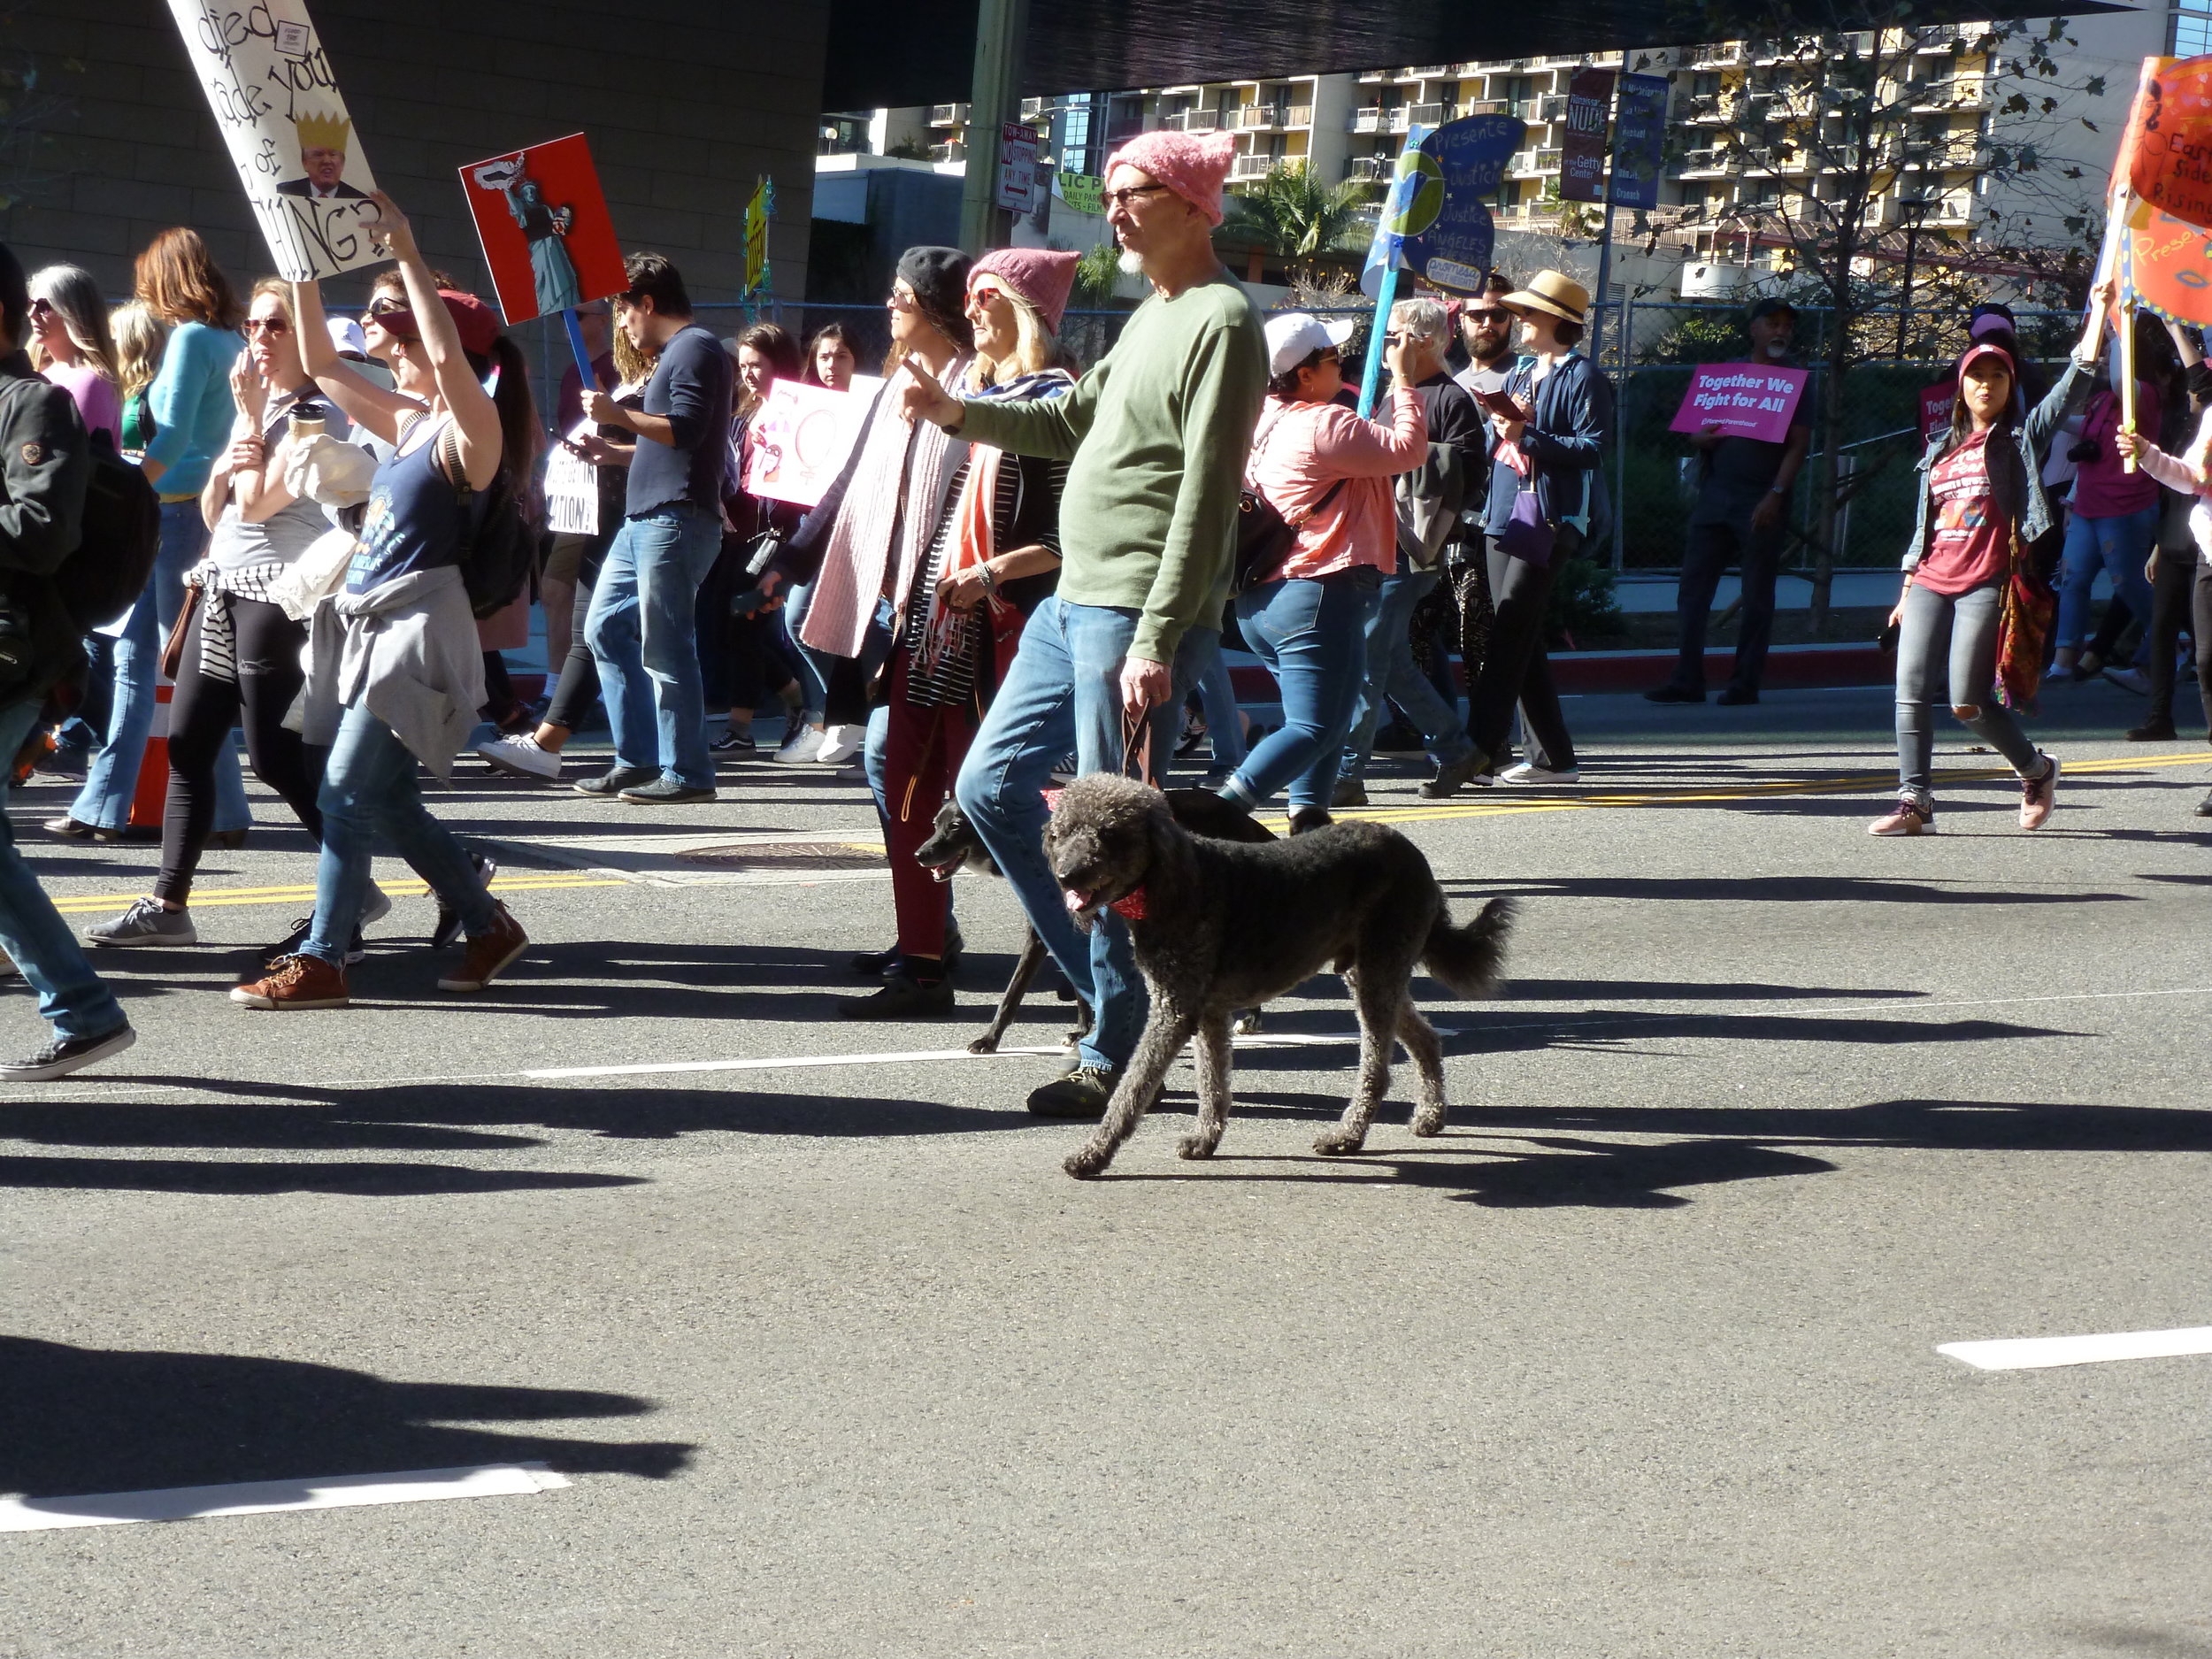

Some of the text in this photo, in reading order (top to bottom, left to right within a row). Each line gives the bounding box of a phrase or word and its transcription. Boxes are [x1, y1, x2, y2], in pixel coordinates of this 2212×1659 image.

[267, 47, 337, 125] you
[1004, 125, 1037, 141] TOW-AWAY
[1434, 119, 1508, 152] Presente
[255, 138, 282, 177] of
[1002, 140, 1035, 165] NO STOPPING
[1570, 166, 1594, 180] Center
[1577, 155, 1602, 173] Getty
[1004, 168, 1032, 185] ANY TIME
[1064, 190, 1082, 202] DAILY
[1087, 203, 1102, 212] FILM
[1441, 204, 1488, 227] Justice
[1699, 373, 1794, 395] Together We
[1694, 392, 1786, 412] Fight for All
[1926, 395, 1954, 416] Toge
